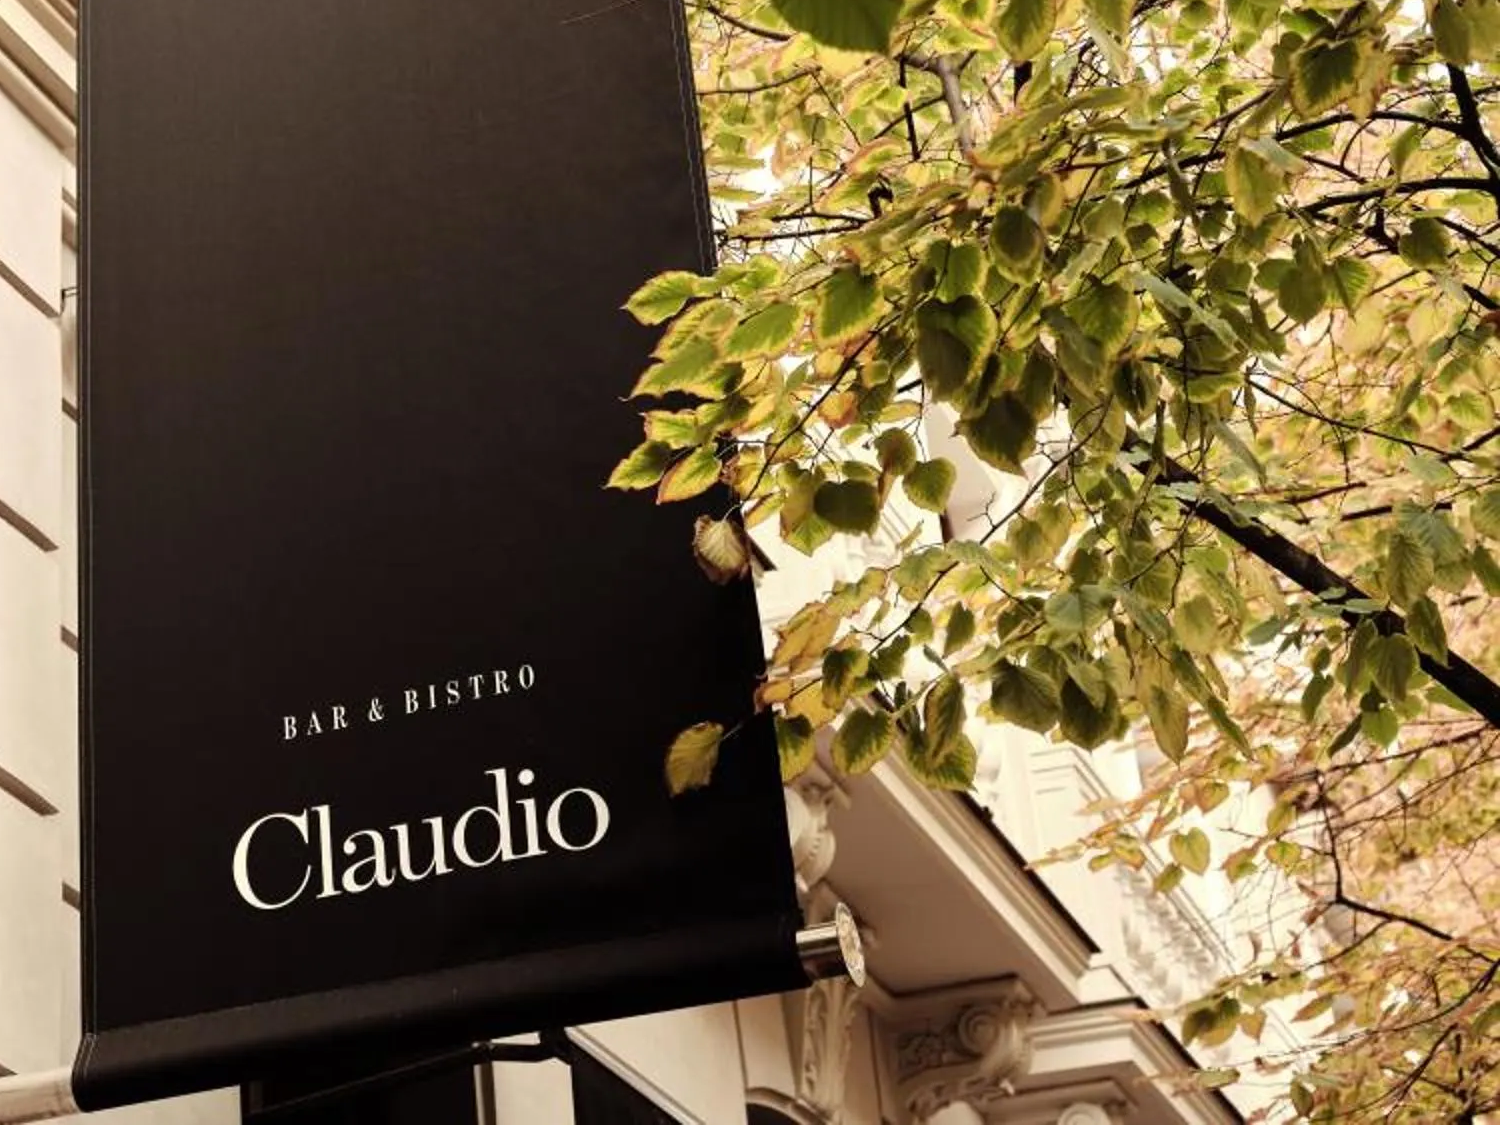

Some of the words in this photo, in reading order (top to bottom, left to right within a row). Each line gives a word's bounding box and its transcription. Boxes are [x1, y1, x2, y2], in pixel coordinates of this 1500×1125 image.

[283, 705, 349, 740] BAR
[368, 697, 386, 722] &
[404, 664, 536, 714] BISTRO
[232, 767, 611, 910] Claudio
